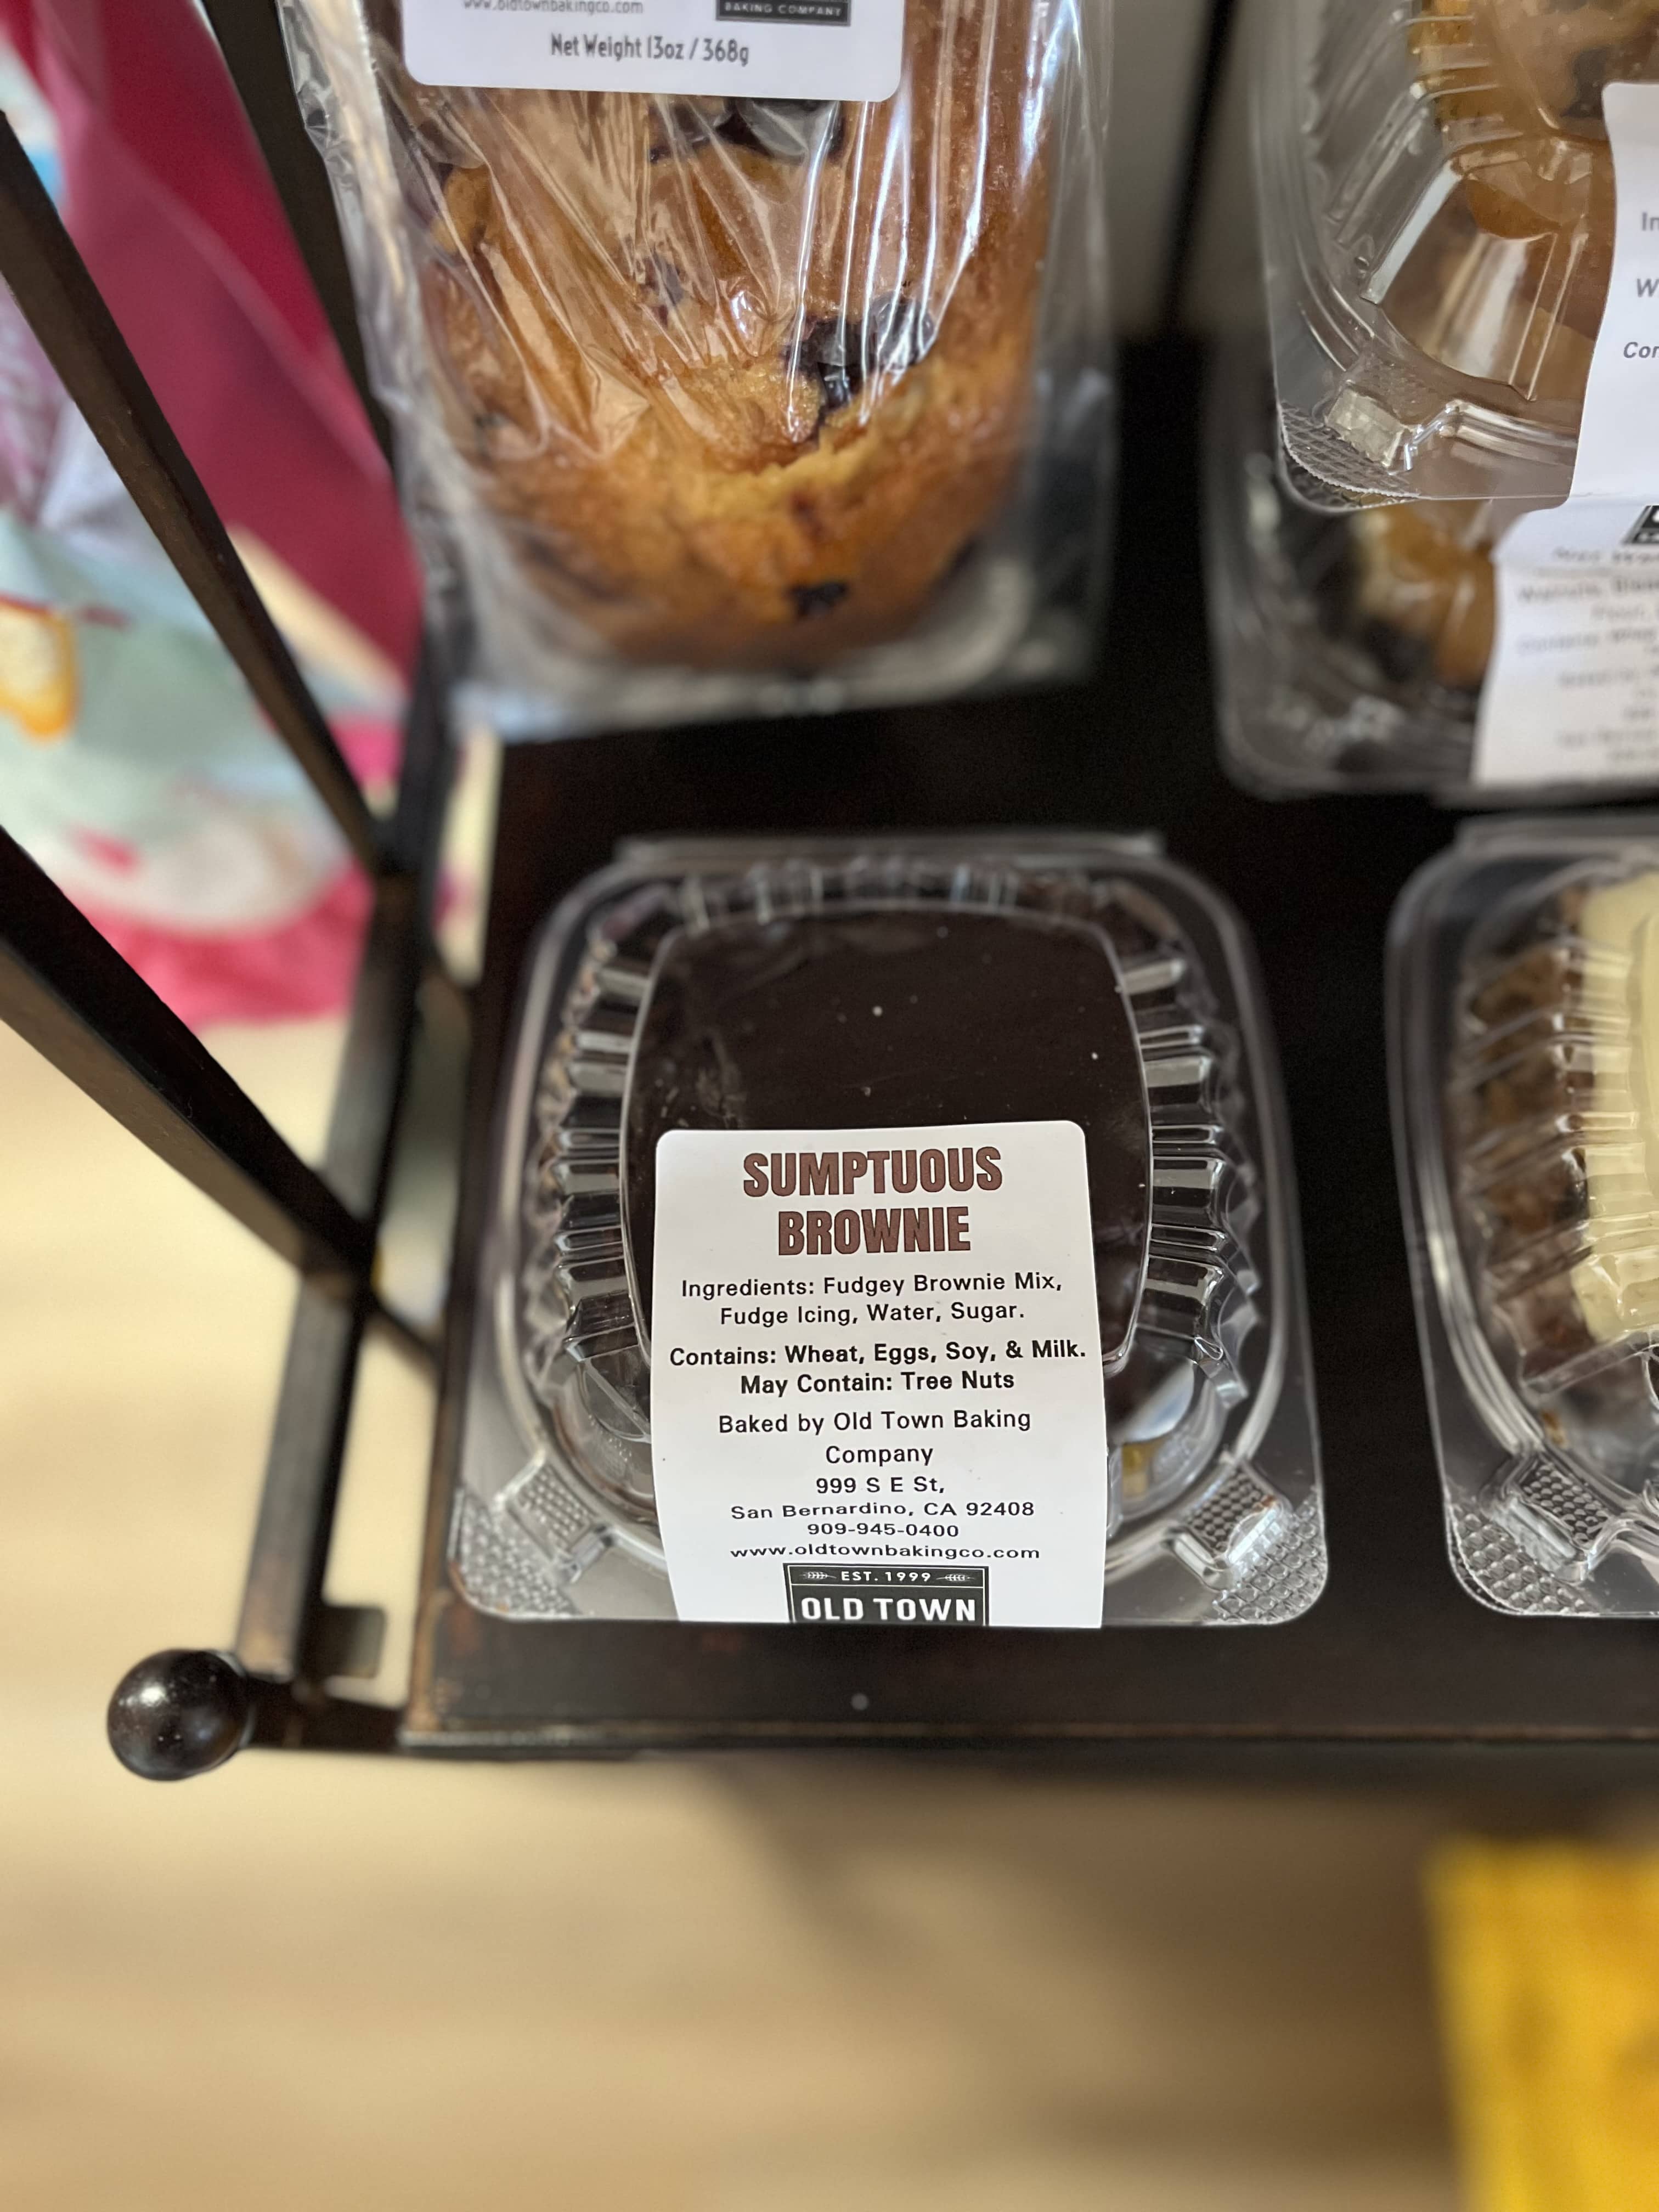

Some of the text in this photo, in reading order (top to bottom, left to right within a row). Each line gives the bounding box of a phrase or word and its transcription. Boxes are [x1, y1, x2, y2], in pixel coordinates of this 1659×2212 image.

[724, 2, 841, 16] BAKING COMPANY
[551, 33, 749, 67] Net Weight 13oz / 368g
[743, 1147, 1002, 1197] SUMPTUOUS
[778, 1206, 970, 1255] BROWNIE
[682, 1272, 1061, 1300] Ingredients: Fudgey Brownie Mix,
[721, 1302, 1024, 1328] Fudge Icing, Water, Sugar.
[670, 1340, 1085, 1365] Contains: Wheat, Eggs, Soy, & Milk.
[742, 1370, 1014, 1397] May Contain: Tree Nuts
[720, 1409, 1030, 1435] Baked by Old Town Baking
[826, 1446, 933, 1466] Company
[816, 1476, 944, 1493] 999 S E St,
[731, 1502, 1034, 1519] San Bernardino, CA 92408
[808, 1523, 958, 1537] 909-945-0400
[731, 1544, 1039, 1559] www.oldtownbakingco.com
[842, 1571, 930, 1581] EST. 1999
[802, 1598, 975, 1621] OLD TOWN
